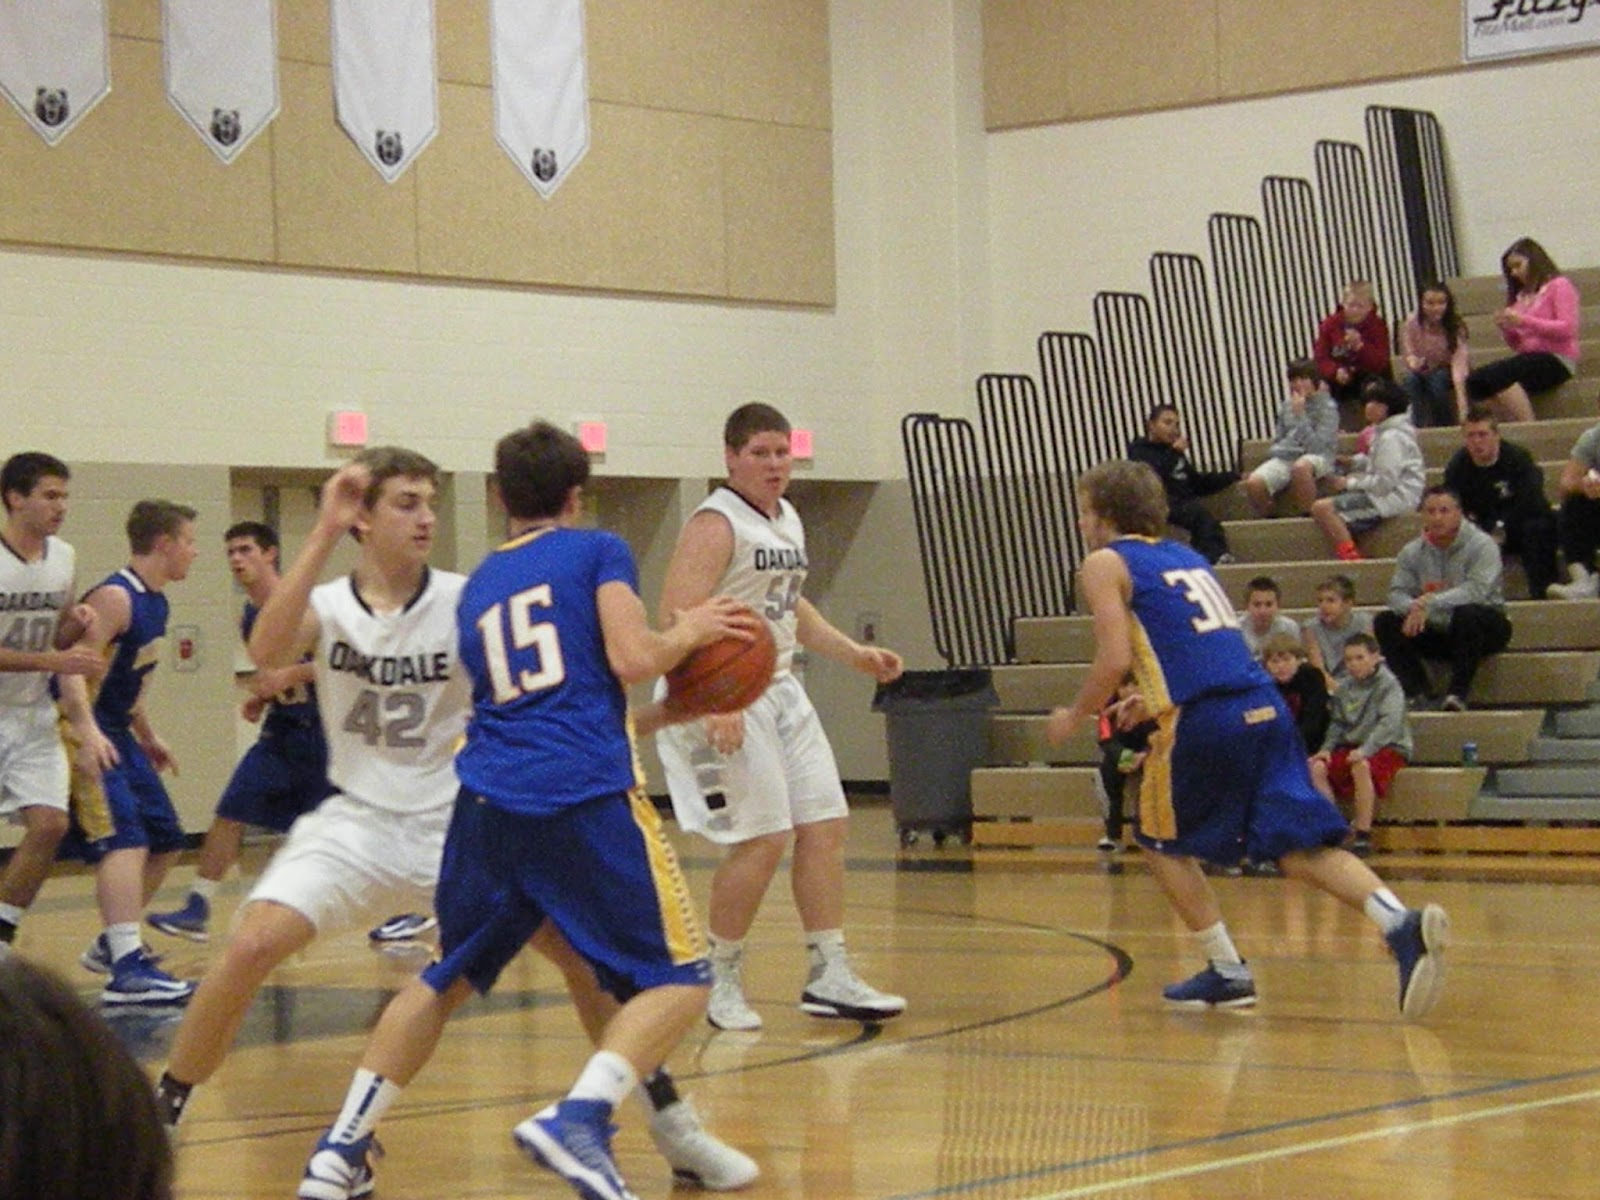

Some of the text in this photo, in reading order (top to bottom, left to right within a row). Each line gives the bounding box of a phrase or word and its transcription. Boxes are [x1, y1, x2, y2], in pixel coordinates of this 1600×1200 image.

[329, 641, 450, 686] OAKDALE
[476, 582, 565, 705] 15
[344, 689, 427, 748] 42
